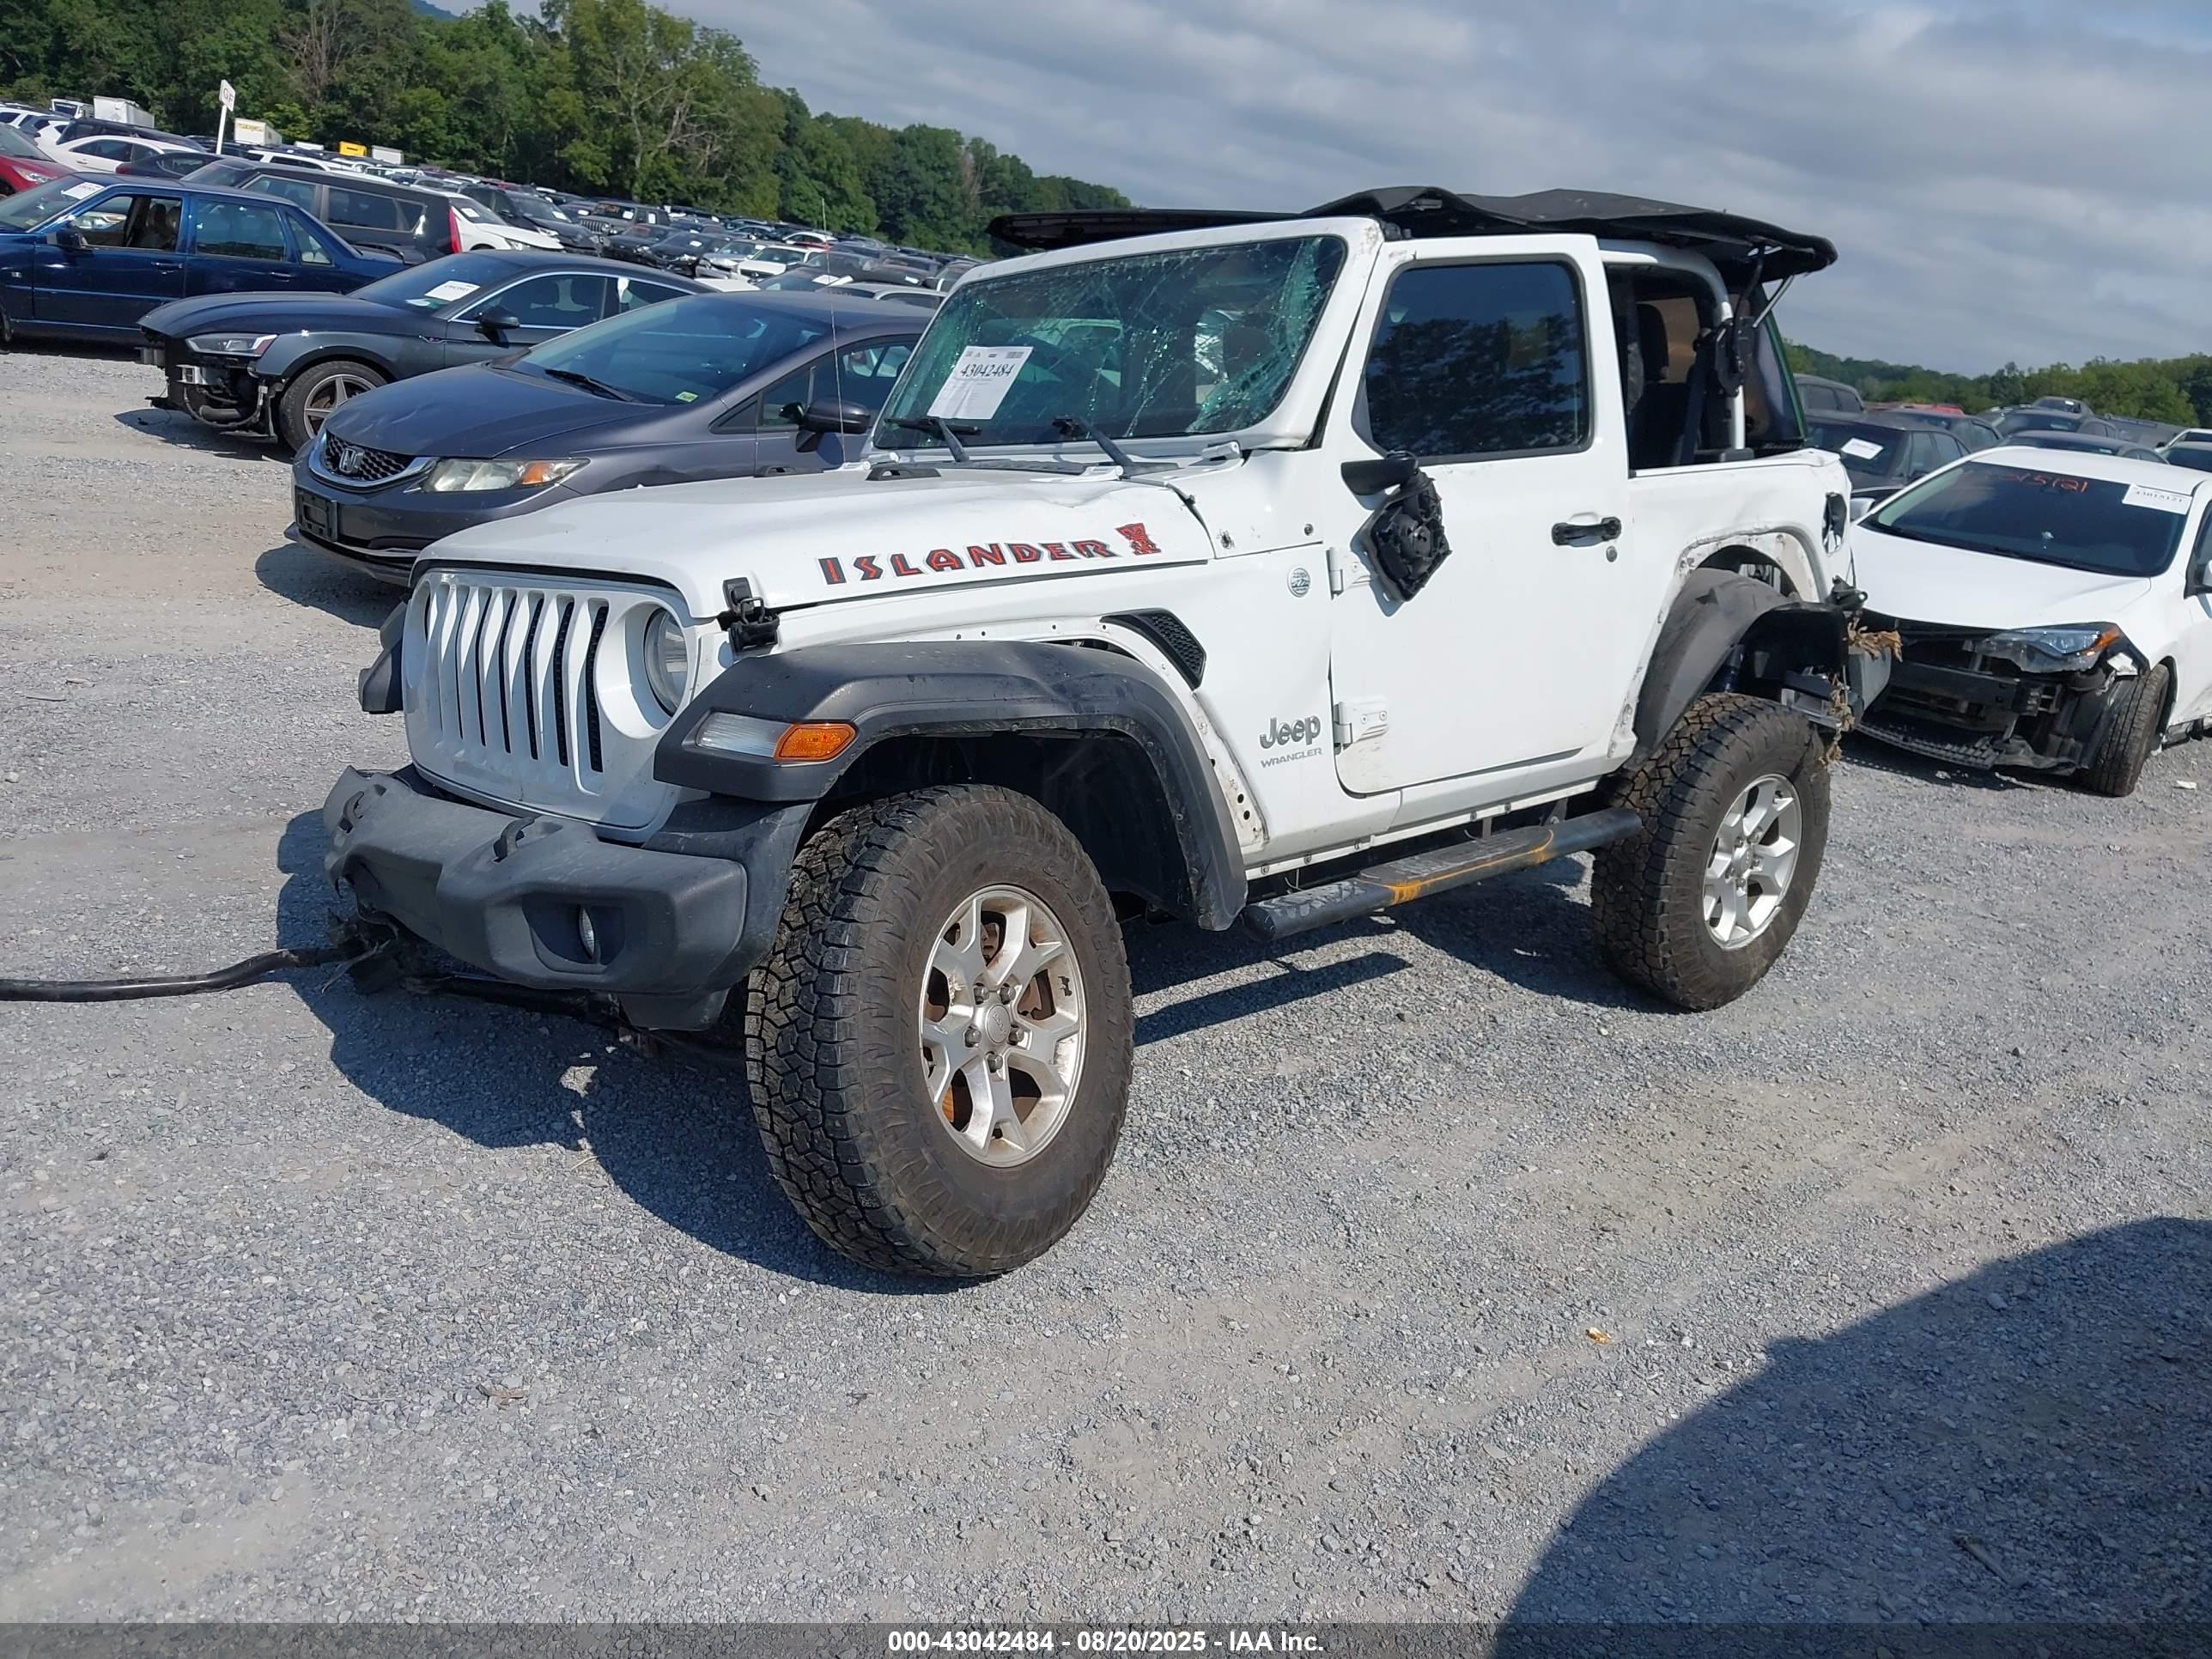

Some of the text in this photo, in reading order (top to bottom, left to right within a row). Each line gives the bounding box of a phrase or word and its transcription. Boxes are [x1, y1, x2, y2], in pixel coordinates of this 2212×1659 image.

[960, 363, 1016, 378] 43042484
[817, 539, 1119, 585] ISLANDER
[1260, 715, 1322, 749] Jeep
[1261, 748, 1322, 768] WRANGLER
